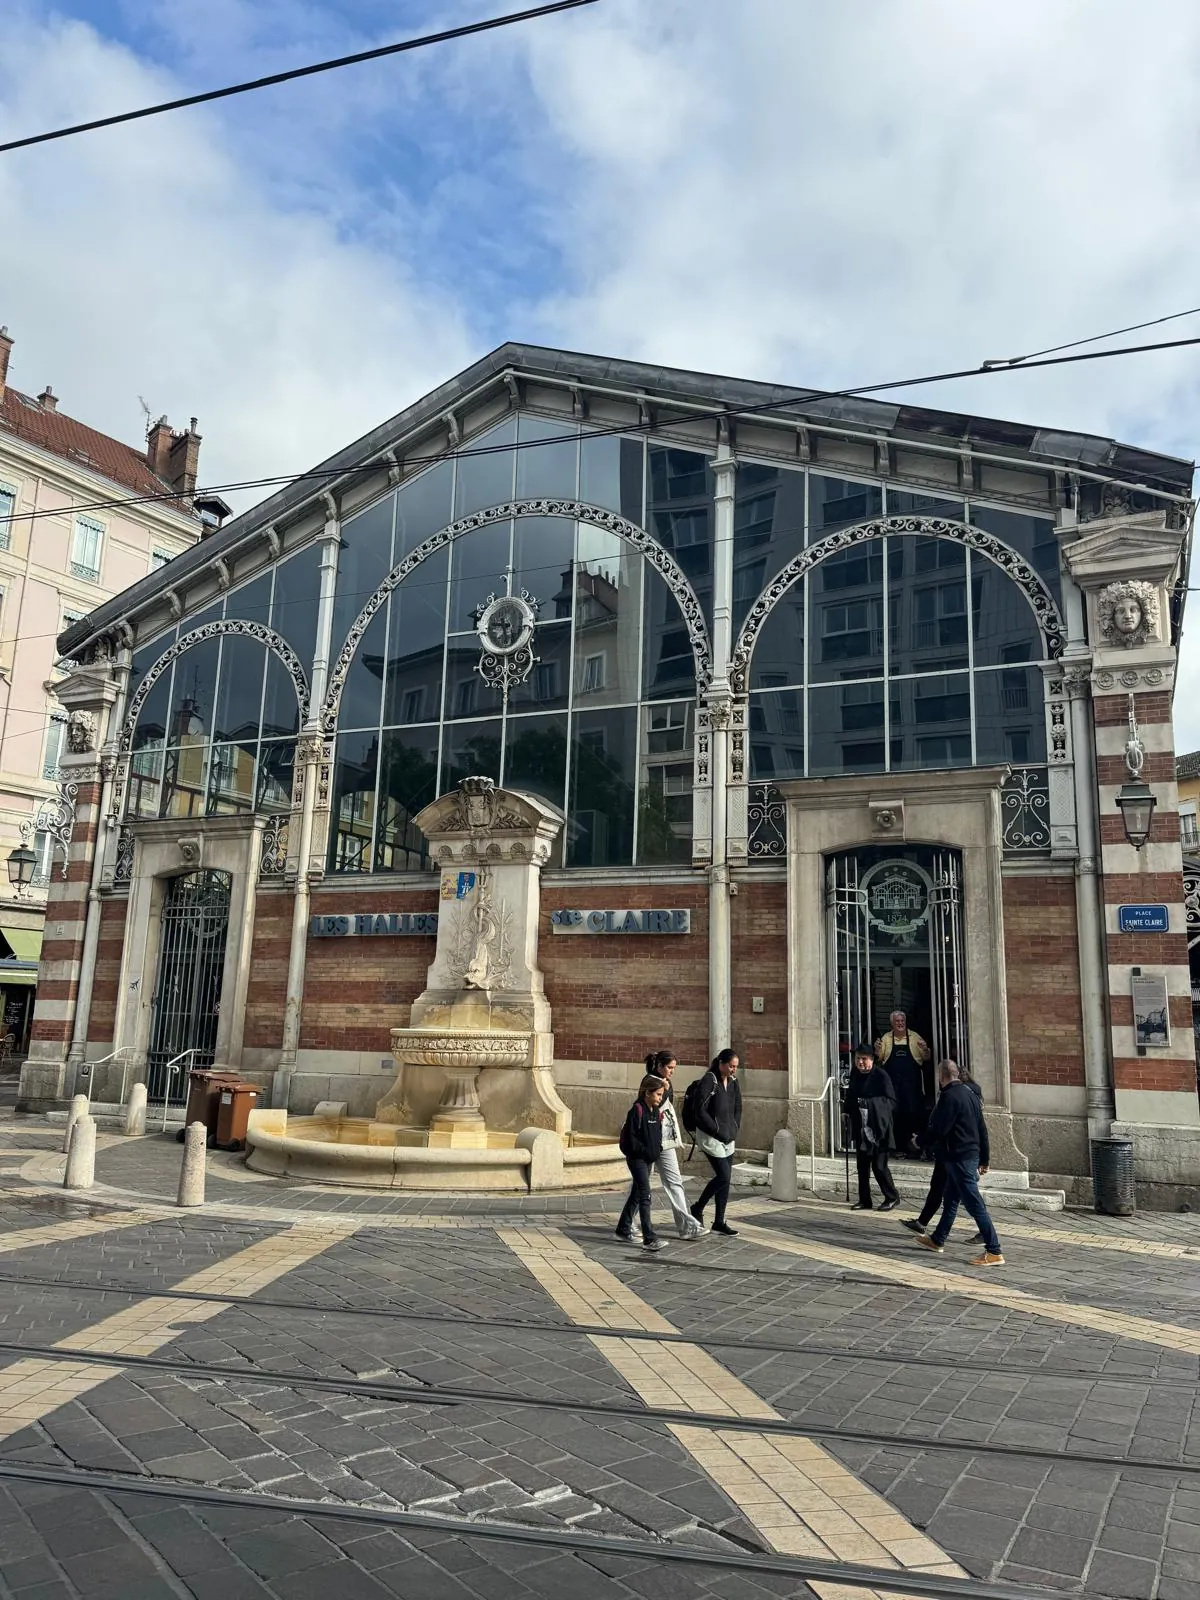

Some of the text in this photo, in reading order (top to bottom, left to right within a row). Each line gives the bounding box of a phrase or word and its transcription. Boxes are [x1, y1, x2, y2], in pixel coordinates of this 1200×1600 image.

[312, 916, 349, 935] LES
[353, 914, 438, 934] HALLES
[587, 910, 688, 933] CLAIRE
